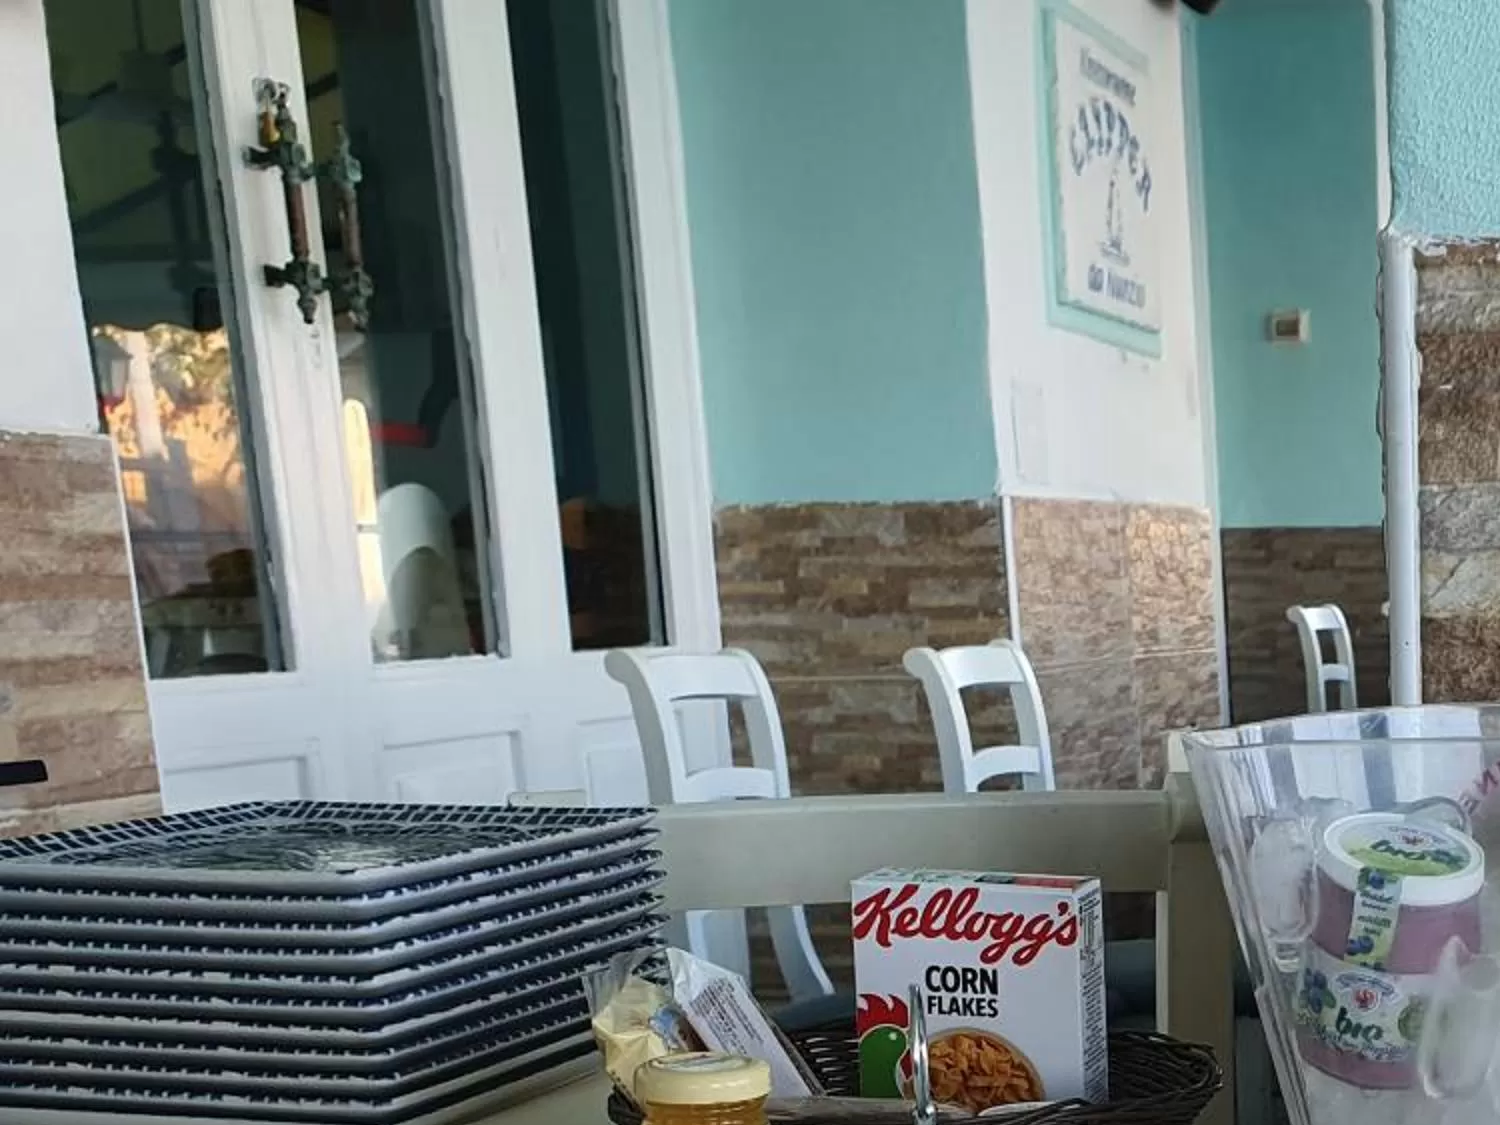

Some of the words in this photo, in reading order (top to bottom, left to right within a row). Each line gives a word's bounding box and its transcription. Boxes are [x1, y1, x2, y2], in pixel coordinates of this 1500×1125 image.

[853, 884, 1079, 965] Kellogg's
[925, 966, 998, 995] CORN
[927, 996, 998, 1018] FLAKES
